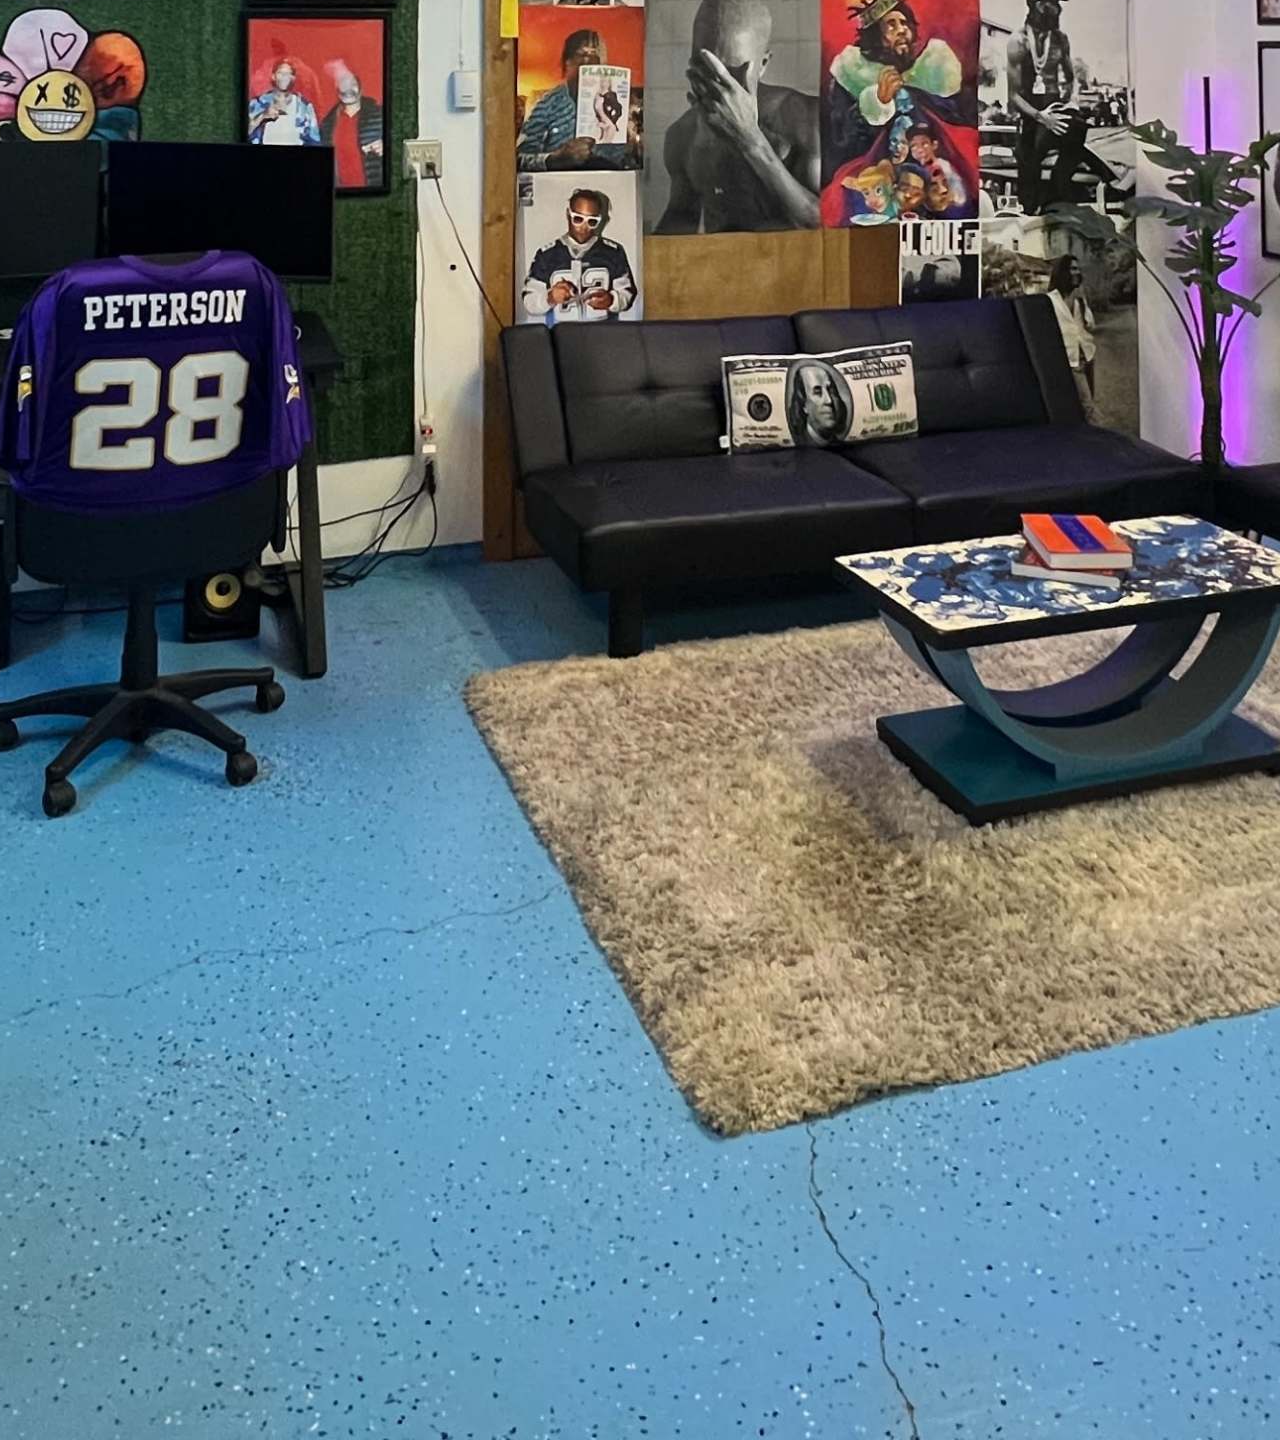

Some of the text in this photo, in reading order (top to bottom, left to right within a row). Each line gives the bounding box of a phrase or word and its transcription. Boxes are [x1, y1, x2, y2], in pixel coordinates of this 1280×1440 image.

[920, 221, 963, 256] COLE
[84, 289, 246, 330] PETERSON
[70, 350, 249, 470] 28
